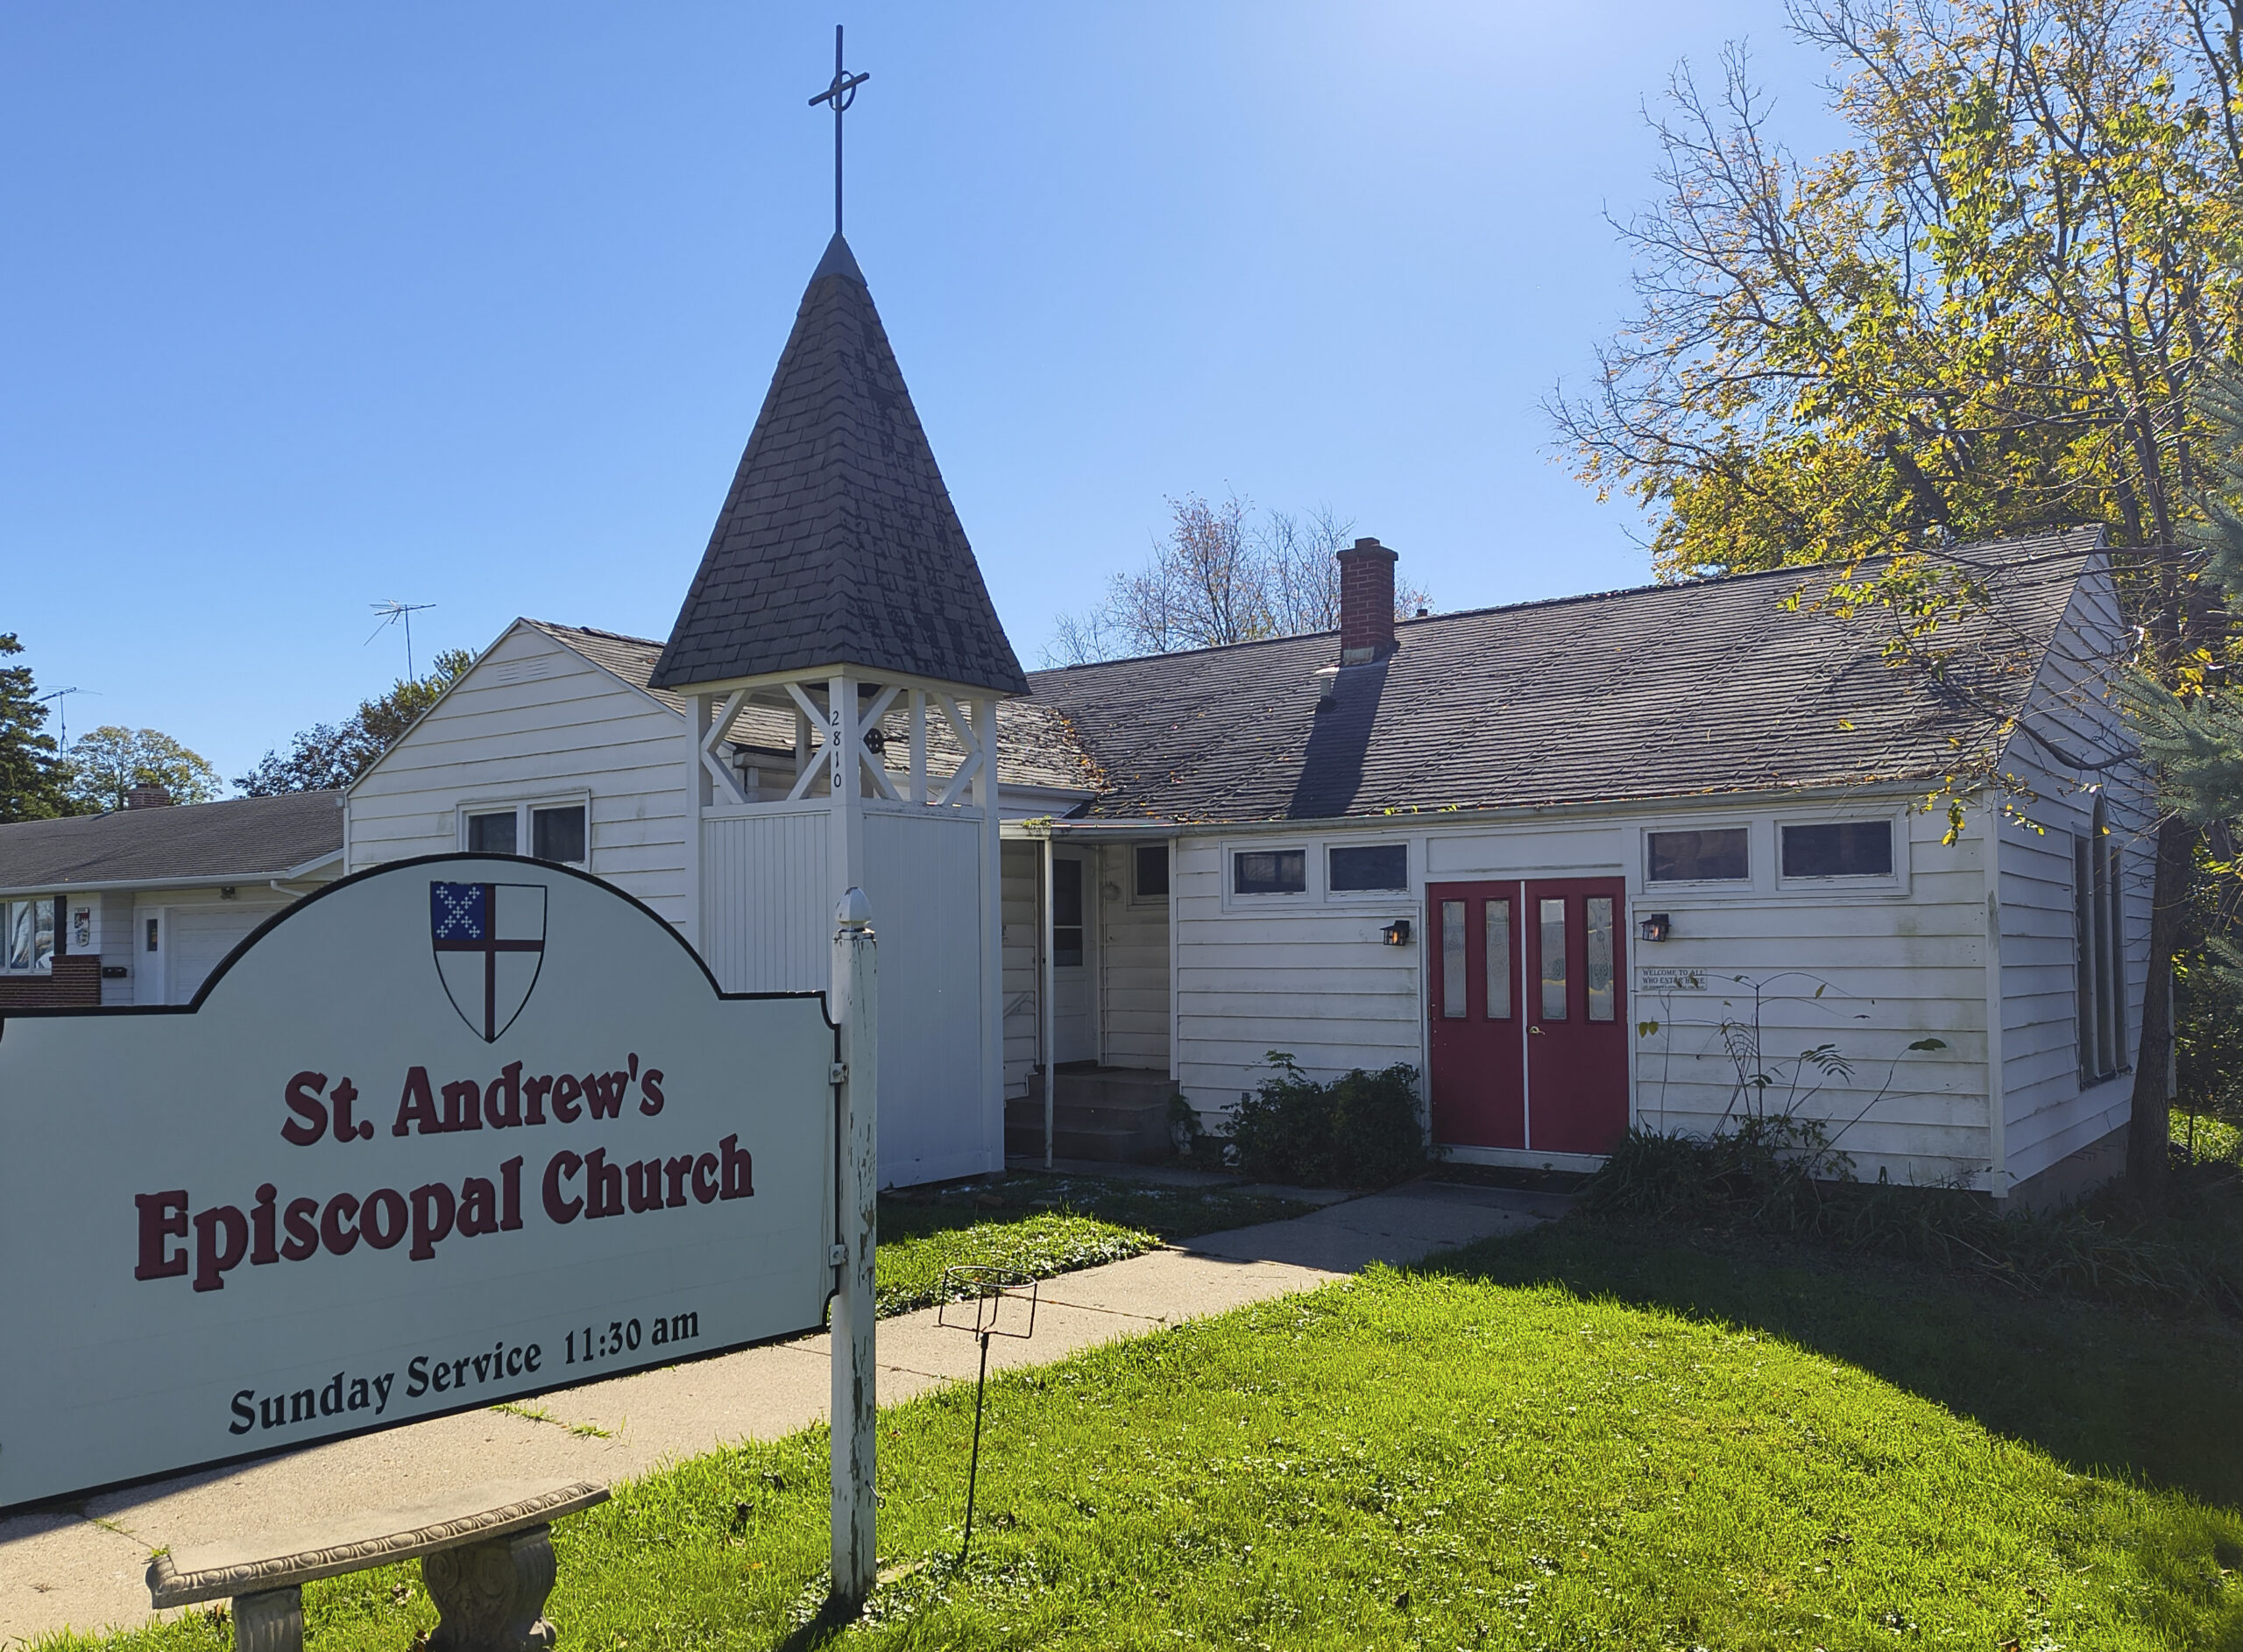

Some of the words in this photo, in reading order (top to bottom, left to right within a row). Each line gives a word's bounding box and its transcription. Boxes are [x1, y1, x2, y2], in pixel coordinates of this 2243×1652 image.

[831, 710, 841, 787] 2810
[280, 1071, 374, 1147] St.
[392, 1052, 665, 1138] Andrew's
[134, 1154, 524, 1294] Episcopal
[541, 1133, 755, 1225] Church
[228, 1371, 395, 1436] Sunday
[406, 1343, 541, 1398] Service
[564, 1317, 642, 1365] 11:30
[651, 1311, 699, 1346] am
